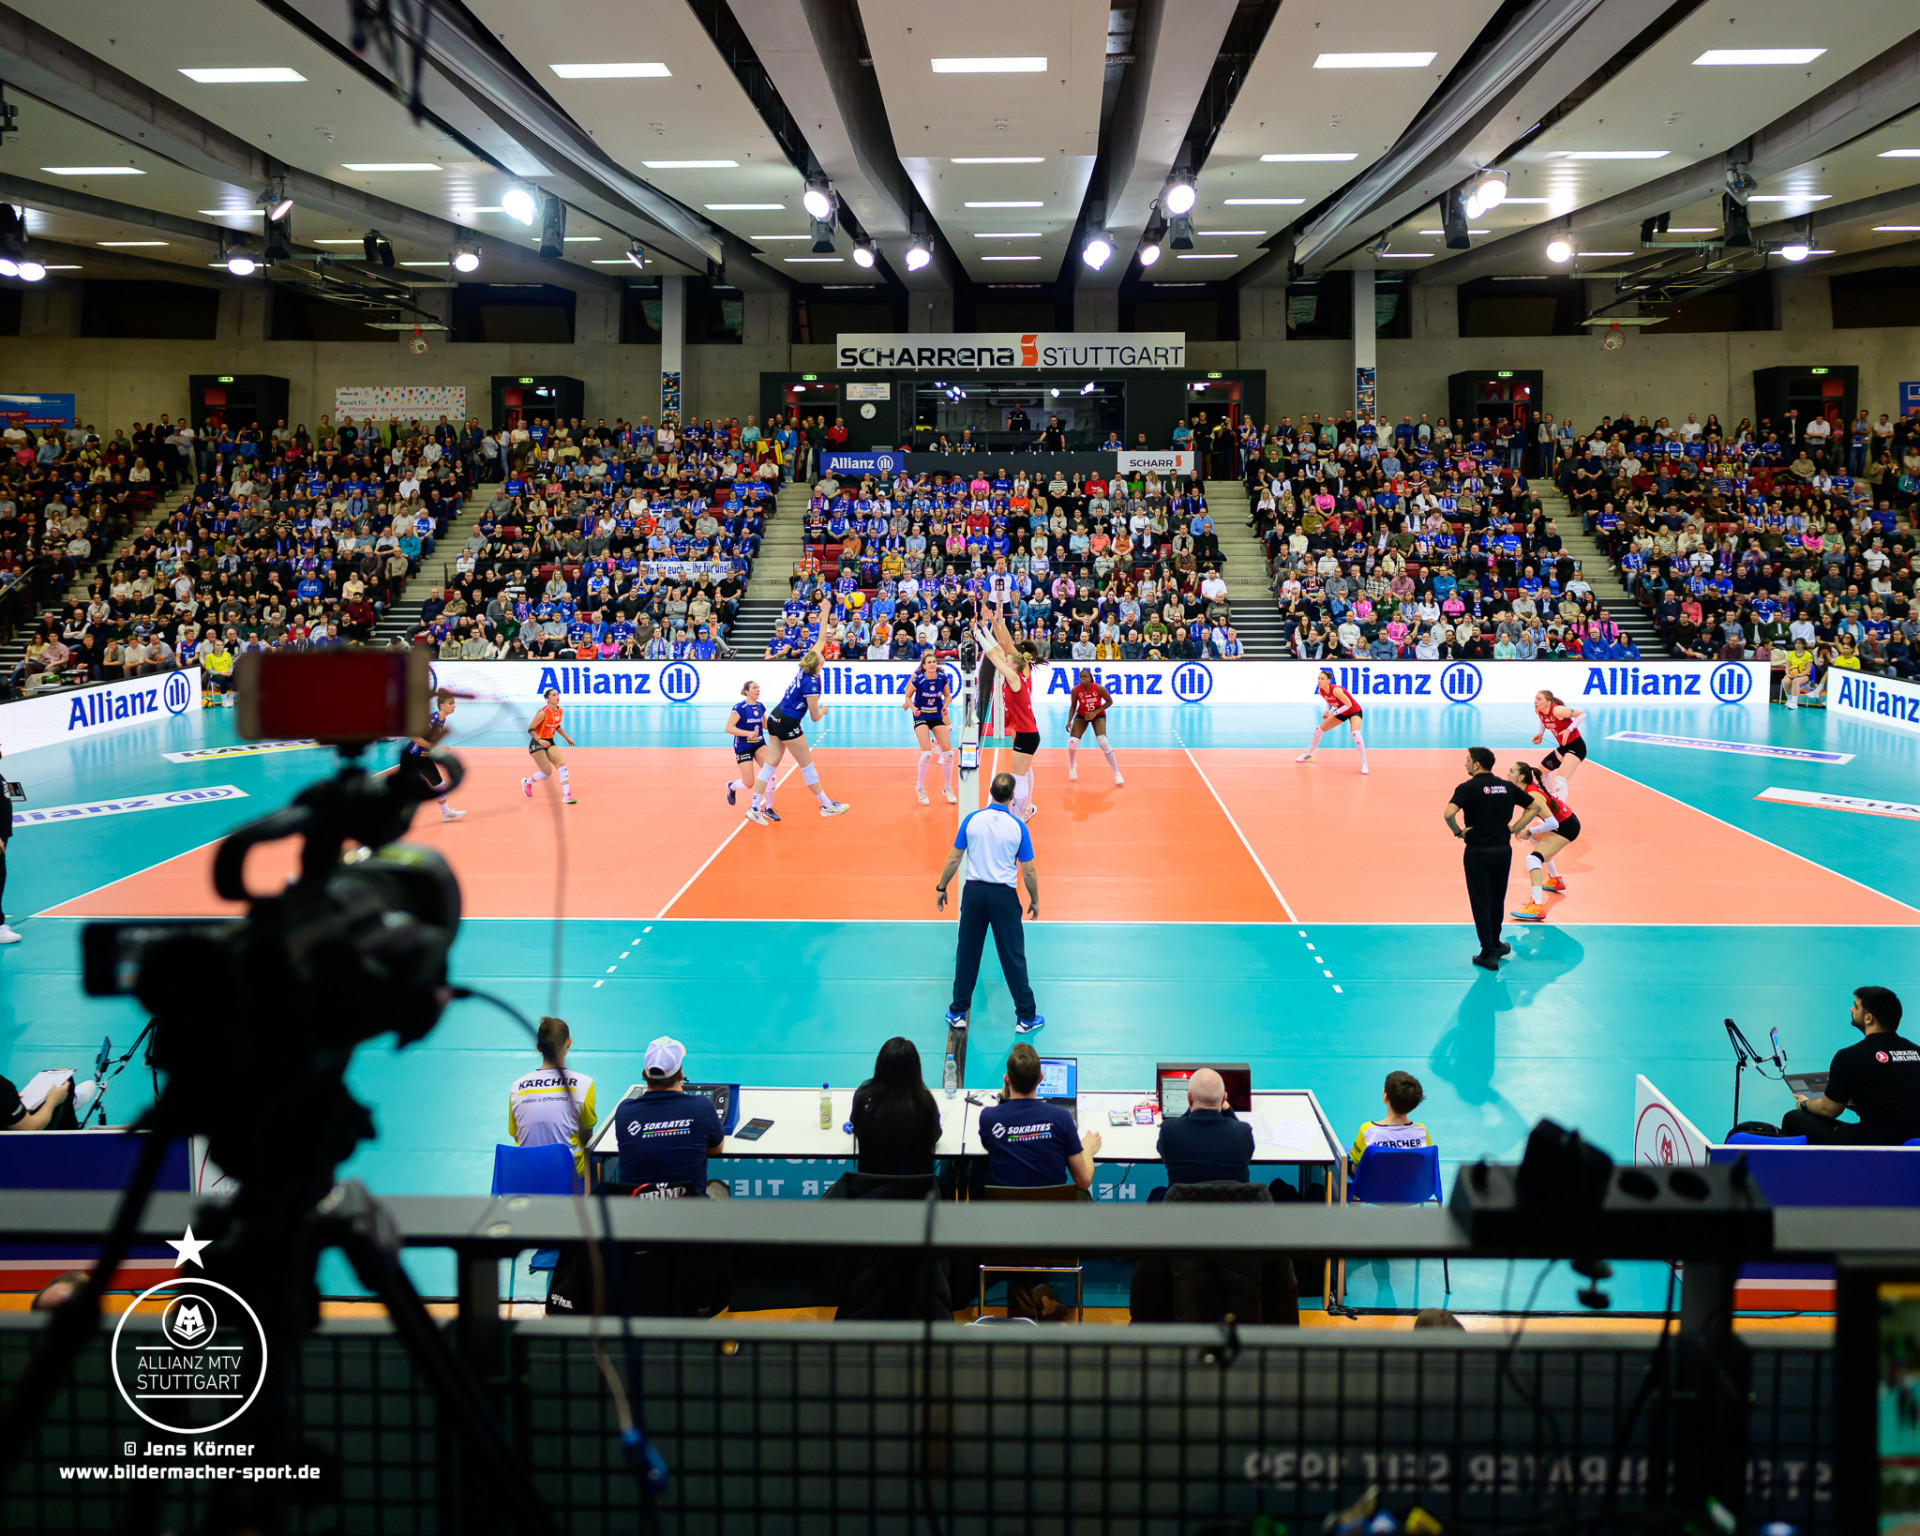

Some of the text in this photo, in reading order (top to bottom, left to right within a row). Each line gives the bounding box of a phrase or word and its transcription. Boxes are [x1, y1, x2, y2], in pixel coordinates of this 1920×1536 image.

[1043, 346, 1184, 366] STUTTGART
[830, 457, 875, 469] Allianz
[668, 564, 684, 574] euch
[704, 562, 713, 573] für
[537, 666, 651, 694] Allianz
[822, 666, 912, 694] llianz
[1583, 667, 1701, 695] Allianz
[68, 688, 158, 731] Allianz
[1086, 703, 1095, 711] 15
[1838, 676, 1920, 723] Allianz
[643, 1119, 690, 1131] SOKRATES
[1008, 1123, 1051, 1134] SOKRATES
